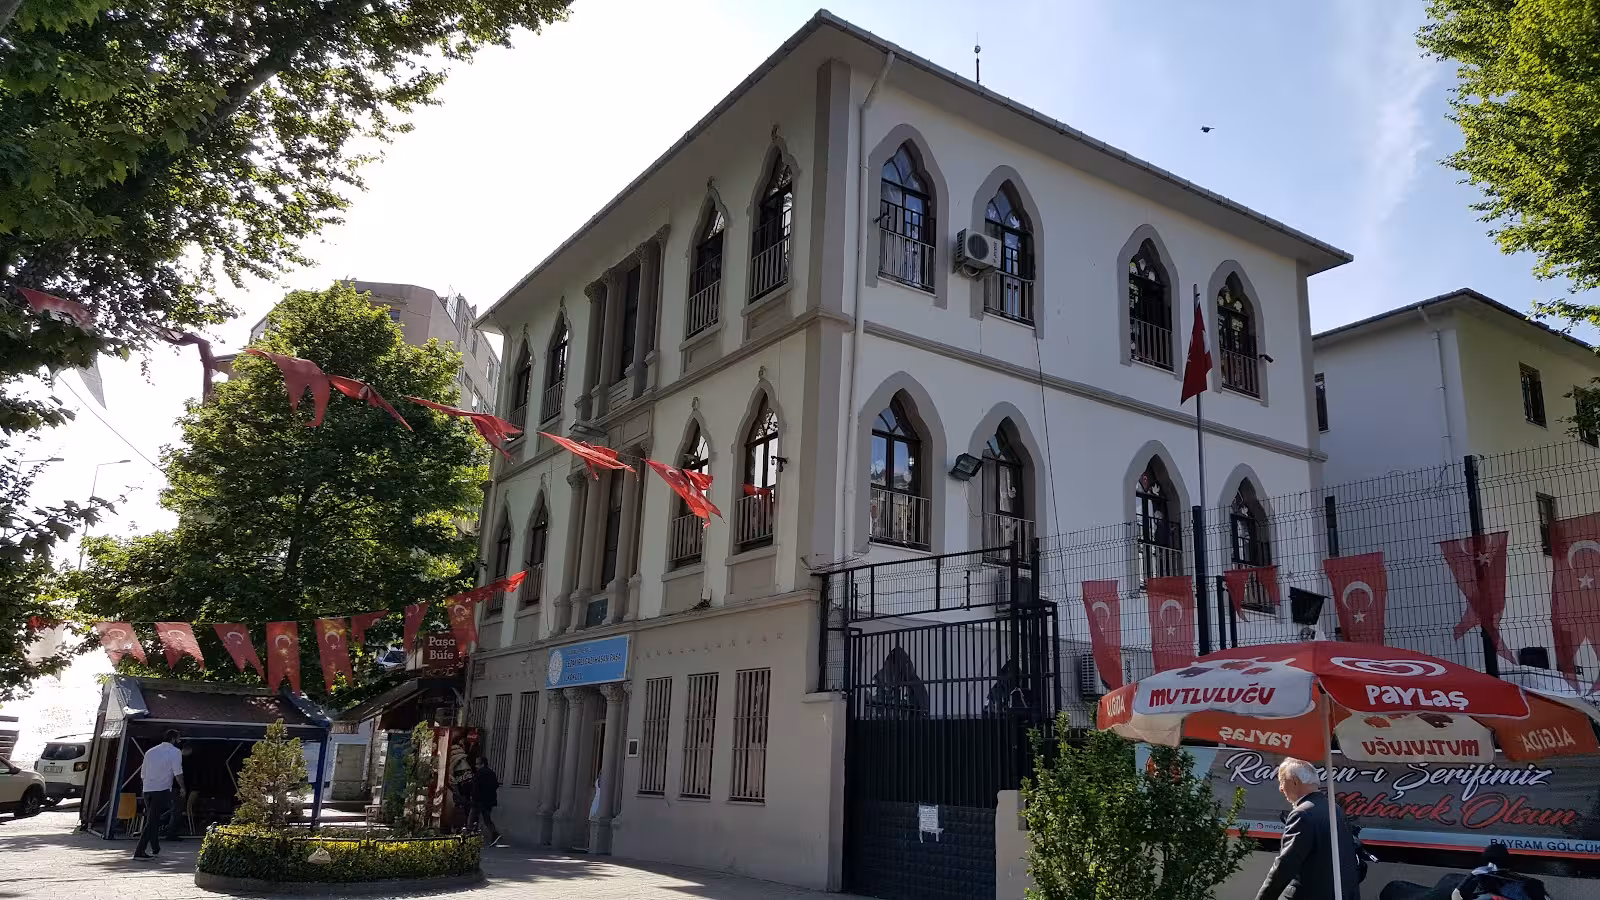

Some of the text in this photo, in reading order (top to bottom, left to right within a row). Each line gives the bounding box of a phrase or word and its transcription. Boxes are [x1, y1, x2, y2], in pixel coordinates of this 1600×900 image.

[428, 636, 456, 649] Paşa
[429, 650, 454, 660] Büfe
[1391, 763, 1553, 802] Şerifimiz
[1460, 791, 1580, 829] Olsun
[1489, 838, 1543, 850] BAYRAM
